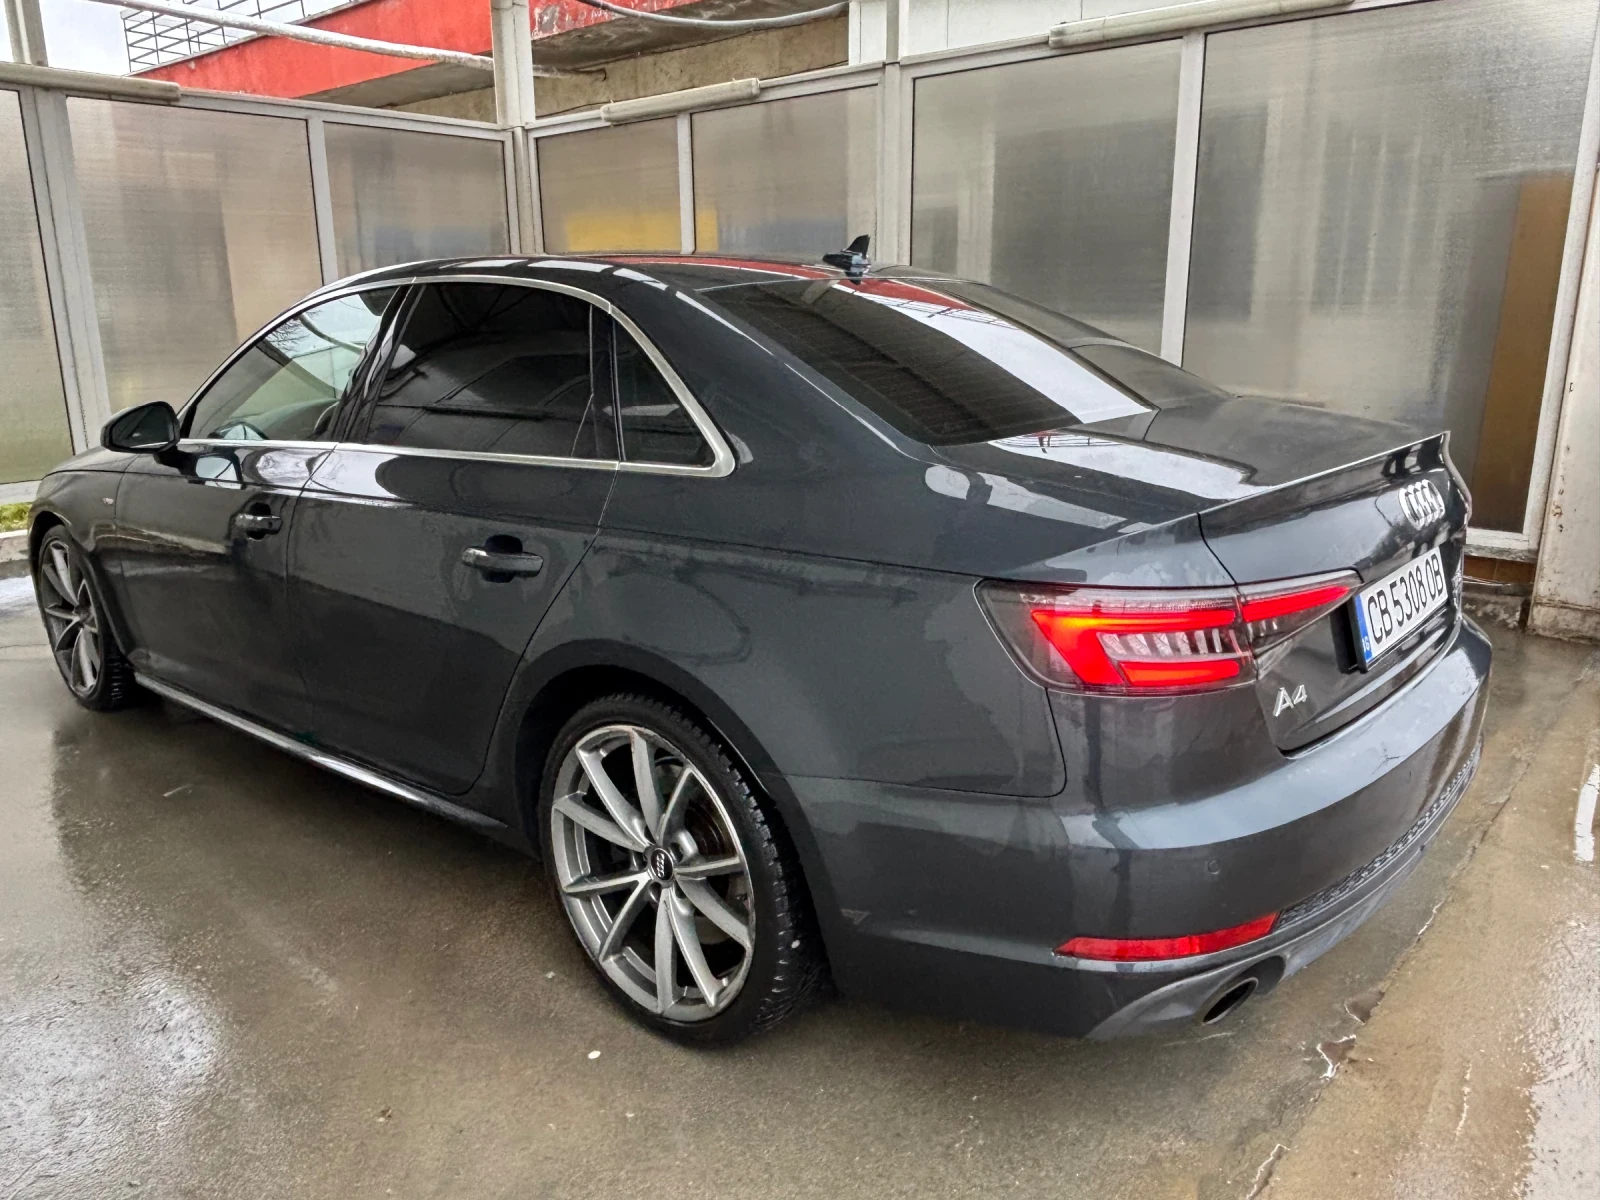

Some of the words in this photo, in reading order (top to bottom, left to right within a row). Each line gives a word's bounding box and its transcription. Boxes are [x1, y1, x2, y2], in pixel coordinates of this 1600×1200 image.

[1367, 589, 1393, 645] CB
[1389, 565, 1428, 627] 5308
[1273, 684, 1308, 717] A4
